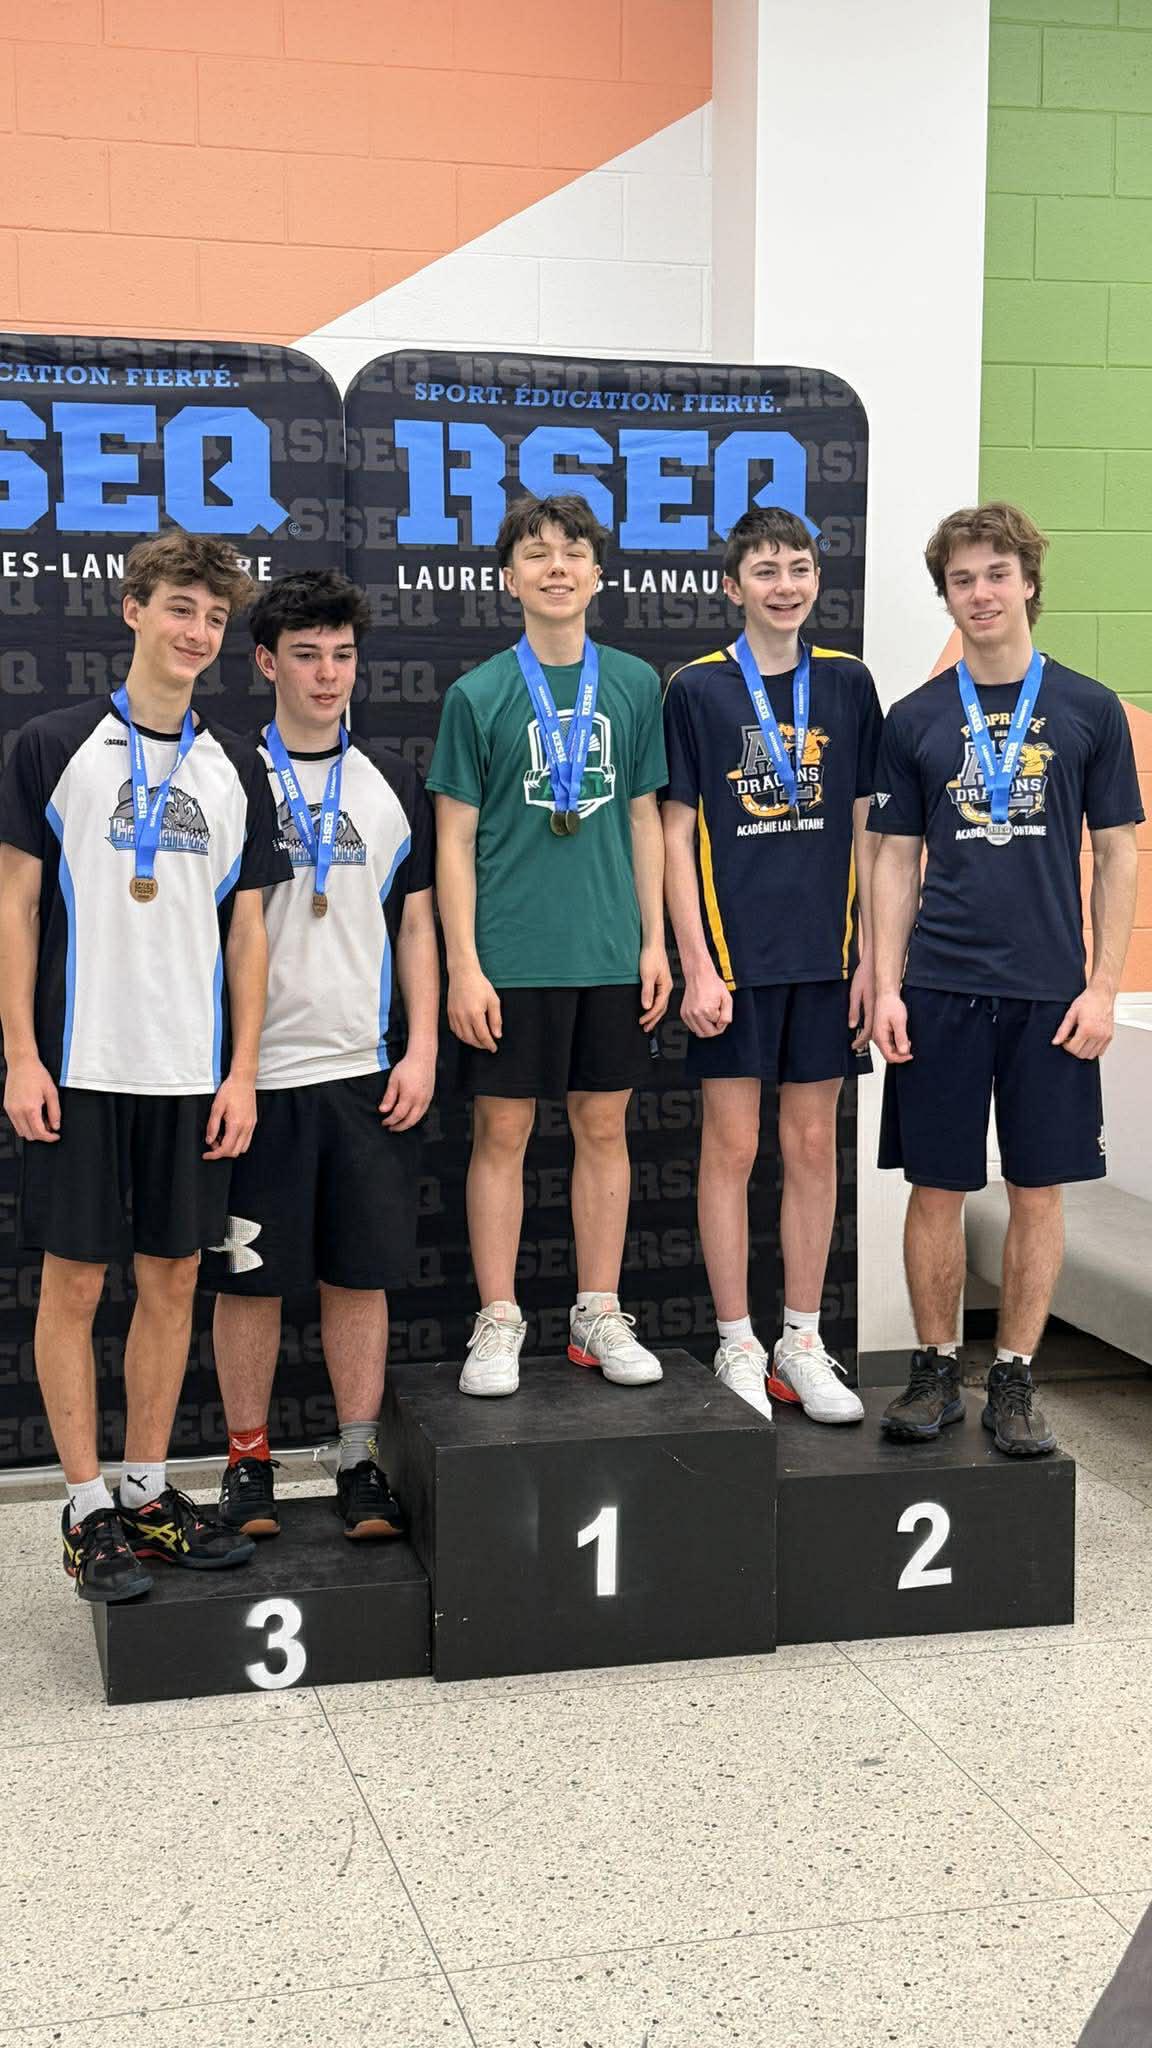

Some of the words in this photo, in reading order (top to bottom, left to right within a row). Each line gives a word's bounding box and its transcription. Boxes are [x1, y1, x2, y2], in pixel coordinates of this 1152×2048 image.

[125, 363, 240, 388] FIERTÉ.
[414, 382, 507, 406] SPORT.
[514, 383, 676, 413] ÉDUCATION.
[682, 391, 783, 414] FIERTÉ.
[394, 418, 822, 551] RSEQ
[736, 820, 777, 838] ACADÉMIE
[577, 1507, 618, 1597] 1
[896, 1502, 953, 1590] 2
[245, 1598, 307, 1690] 3
